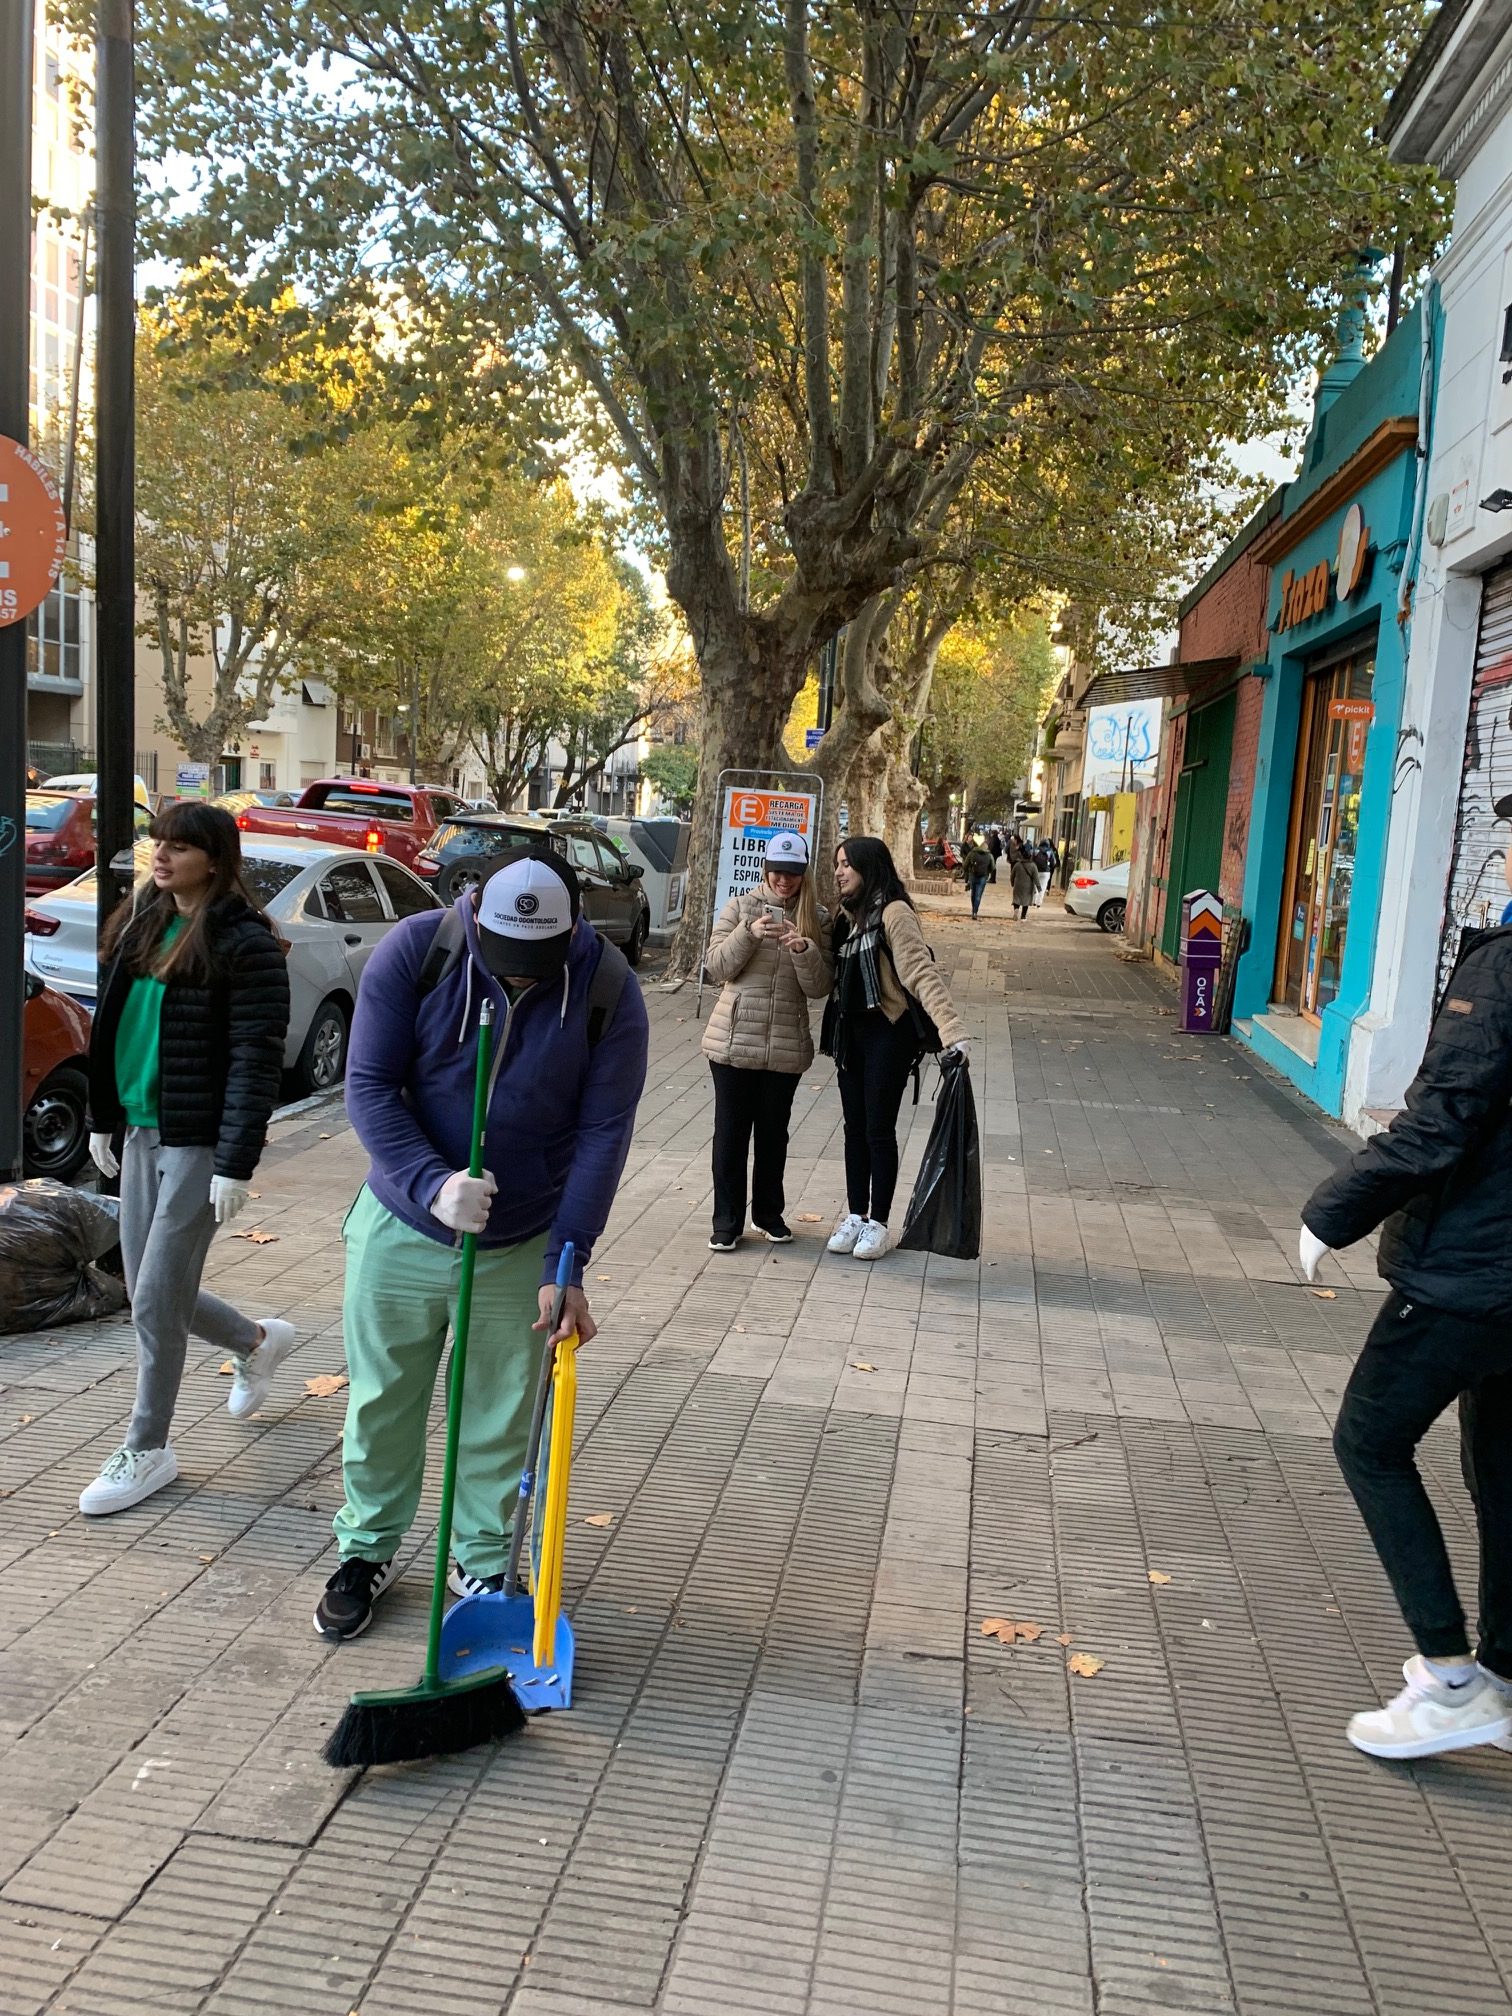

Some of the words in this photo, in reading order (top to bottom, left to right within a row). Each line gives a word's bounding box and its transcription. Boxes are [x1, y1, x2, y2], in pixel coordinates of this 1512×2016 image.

[15, 445, 58, 500] HABILES
[54, 506, 64, 515] 7
[56, 521, 66, 532] A
[55, 538, 64, 554] 14
[48, 558, 62, 579] HS
[1344, 705, 1370, 716] pickit
[1351, 721, 1361, 756] E
[740, 799, 758, 823] E
[769, 800, 804, 810] RECARGA
[770, 821, 800, 829] MEDIDO
[494, 912, 518, 923] SOCIEDAD
[1195, 977, 1207, 1006] OCA
